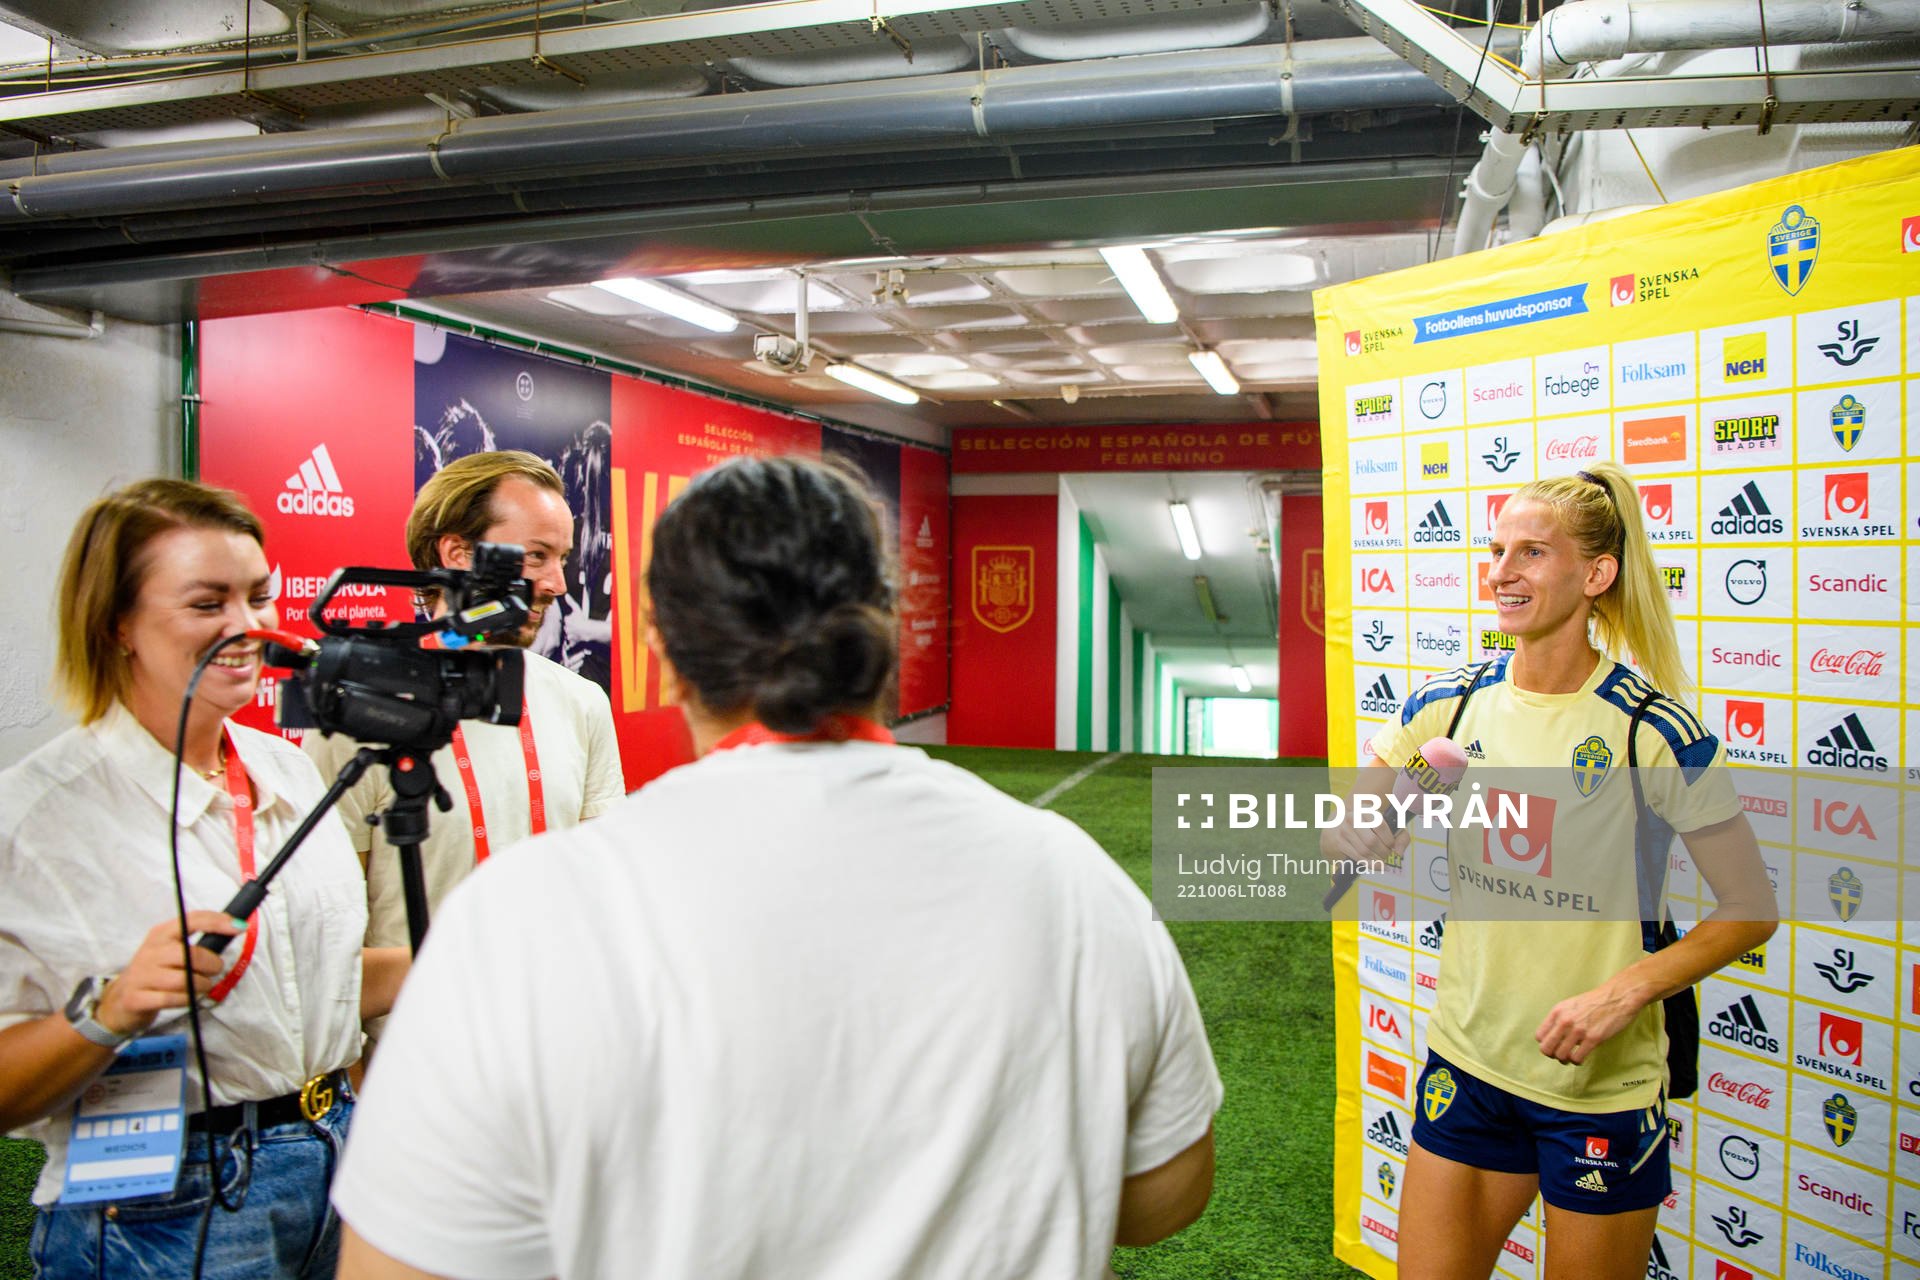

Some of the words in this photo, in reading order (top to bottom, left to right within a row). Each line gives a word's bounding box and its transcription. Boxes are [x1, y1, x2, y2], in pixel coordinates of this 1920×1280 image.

[1774, 227, 1813, 243] SVERIGE
[1640, 267, 1700, 289] SVENSKA
[1640, 287, 1671, 302] SPEL
[1425, 313, 1484, 335] Fotbollens
[1484, 294, 1573, 325] huvudsponsor
[1363, 326, 1404, 342] SVENSKA
[1837, 319, 1859, 342] SJ
[1363, 341, 1386, 354] SPEL
[1621, 361, 1687, 384] Folksam
[1472, 382, 1524, 403] Scandic
[1544, 375, 1600, 398] Fabege
[1354, 394, 1393, 417] SPORT
[704, 423, 754, 442] SELECCIÓN
[1713, 413, 1780, 443] SPORT
[678, 432, 728, 451] ESPAÑOLA
[960, 434, 1091, 451] SELECCIÓN
[1101, 431, 1228, 449] ESPAÑOLA
[1239, 432, 1270, 446] DE
[1494, 436, 1508, 453] SJ
[1626, 435, 1669, 449] Swedbank
[1717, 440, 1777, 452] BLADET
[1100, 450, 1226, 466] FEMENINO
[1354, 458, 1399, 476] Folksam
[276, 489, 355, 518] adidas
[1413, 527, 1461, 544] adidas
[1668, 530, 1694, 541] SPEL
[1711, 515, 1784, 536] adidas
[1802, 525, 1860, 538] SVENSKA
[1863, 524, 1896, 537] SPEL
[1353, 539, 1385, 549] SVENSKA
[1386, 538, 1404, 548] SPEL
[1361, 567, 1396, 593] ICA
[1415, 573, 1461, 589] Scandic
[1730, 578, 1762, 587] VOLVO
[1809, 573, 1888, 594] Scandic
[286, 608, 305, 620] Por
[338, 605, 348, 618] el
[349, 605, 388, 621] planeta.
[1371, 619, 1384, 635] SJ
[1416, 632, 1461, 656] Fabege
[1711, 647, 1782, 668] Scandic
[1759, 751, 1788, 765] SPEL
[1807, 747, 1889, 773] adidas
[1813, 798, 1878, 841] ICA
[1458, 863, 1538, 903] SVENSKA
[1543, 889, 1601, 914] SPEL
[1360, 922, 1391, 940] SVENSKA
[1391, 930, 1410, 945] SPEL
[1363, 955, 1408, 980] Folksam
[1833, 948, 1855, 971] SJ
[1369, 1004, 1403, 1040] ICA
[1708, 1020, 1780, 1055] adidas
[1796, 1055, 1852, 1081] SVENSKA
[1856, 1072, 1888, 1091] SPEL
[1367, 1128, 1409, 1157] adidas
[1574, 1156, 1603, 1167] SVENSKA
[1603, 1160, 1619, 1169] SPEL
[1723, 1149, 1755, 1166] VOLVO
[1575, 1178, 1608, 1193] adidas
[1797, 1174, 1873, 1217] Scandic
[1727, 1205, 1748, 1228] SJ
